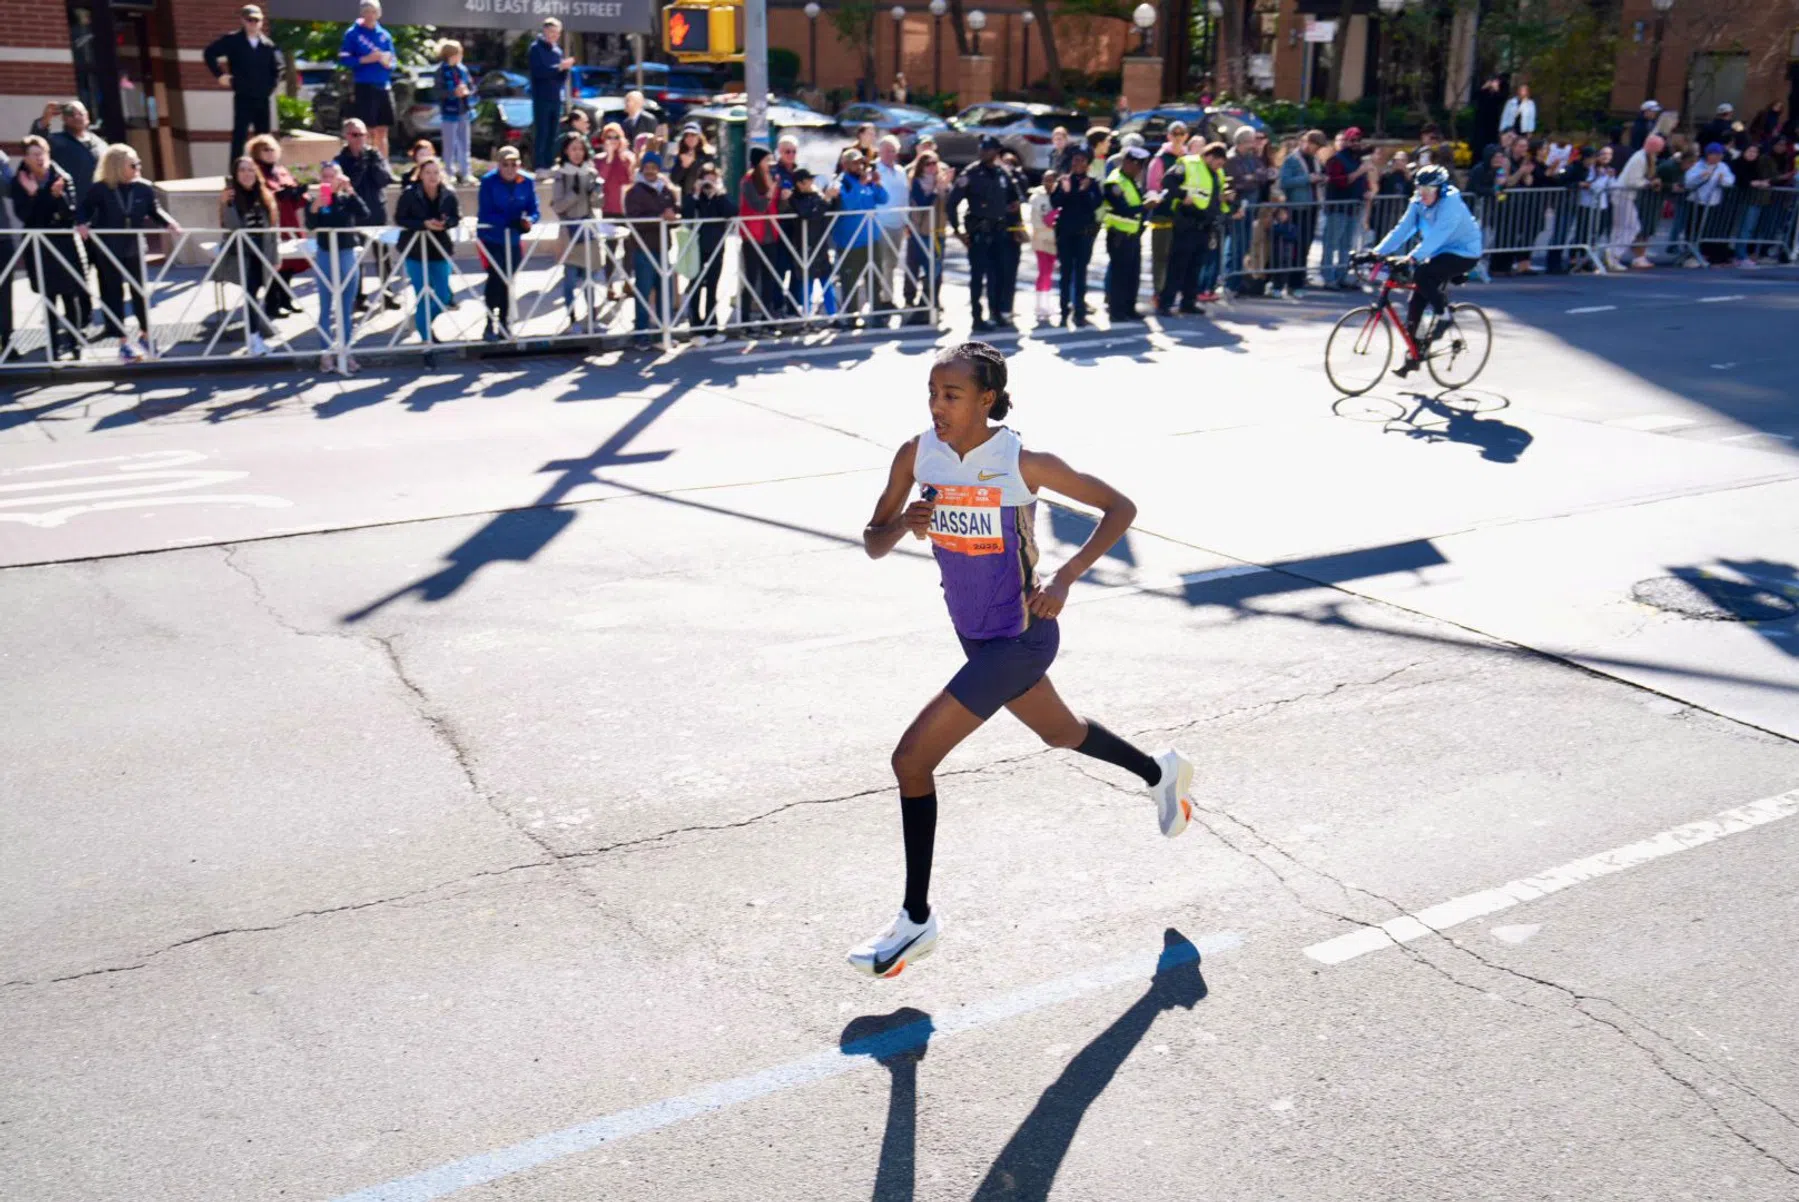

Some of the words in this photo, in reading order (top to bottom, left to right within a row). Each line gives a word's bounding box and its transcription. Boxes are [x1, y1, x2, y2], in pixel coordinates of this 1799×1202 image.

[465, 0, 491, 11] 401
[495, 0, 529, 13] EAST
[532, 0, 569, 14] 84TH
[573, 3, 622, 16] STREET
[930, 510, 992, 535] HASSAN
